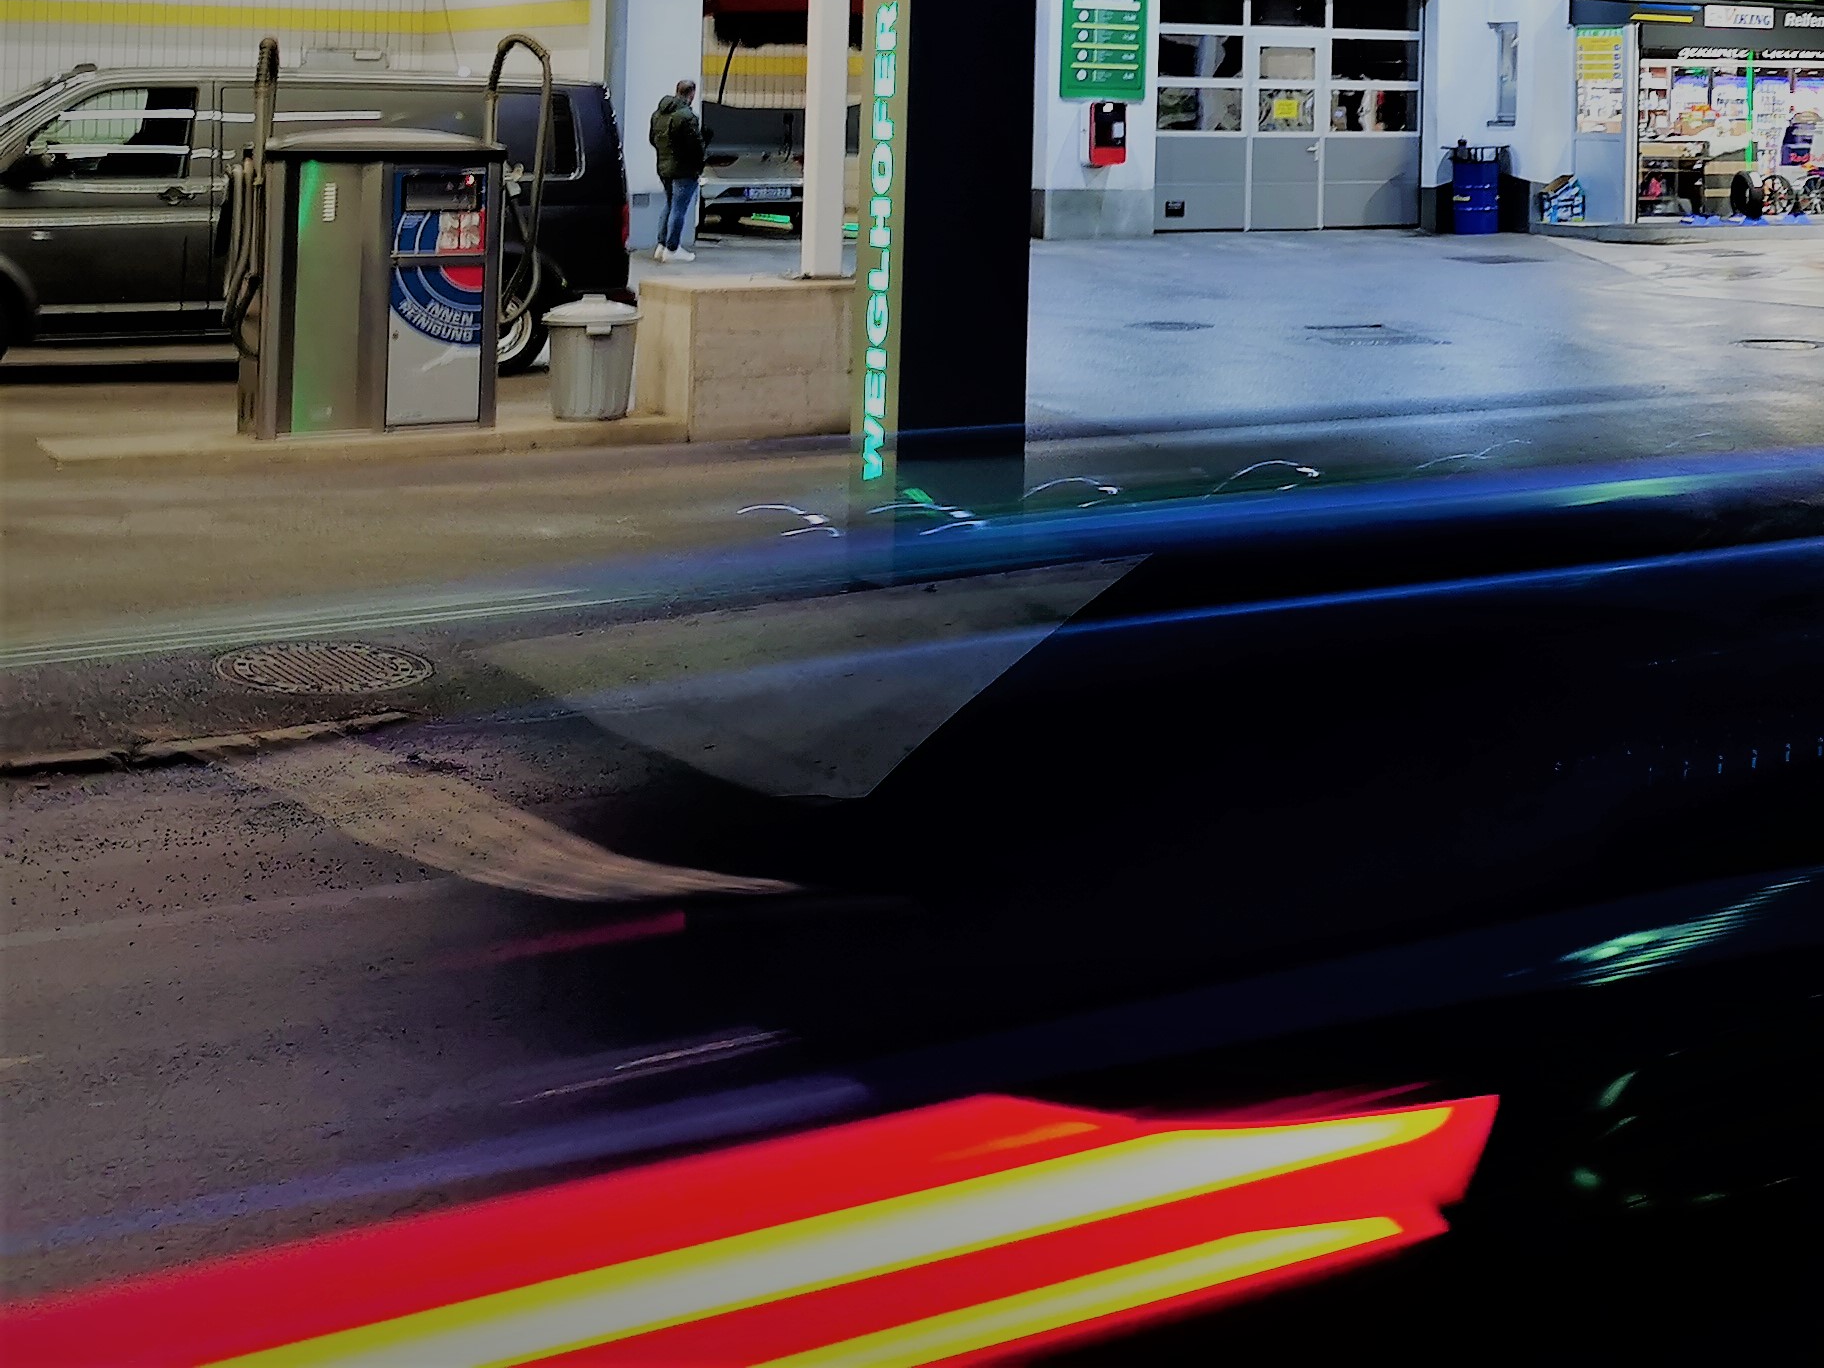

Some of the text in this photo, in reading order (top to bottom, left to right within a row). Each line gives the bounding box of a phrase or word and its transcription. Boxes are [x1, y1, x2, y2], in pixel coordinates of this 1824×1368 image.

[861, 0, 900, 481] WEIGLHOFER
[397, 297, 475, 344] REINIGUNG
[425, 298, 475, 327] INNEN
